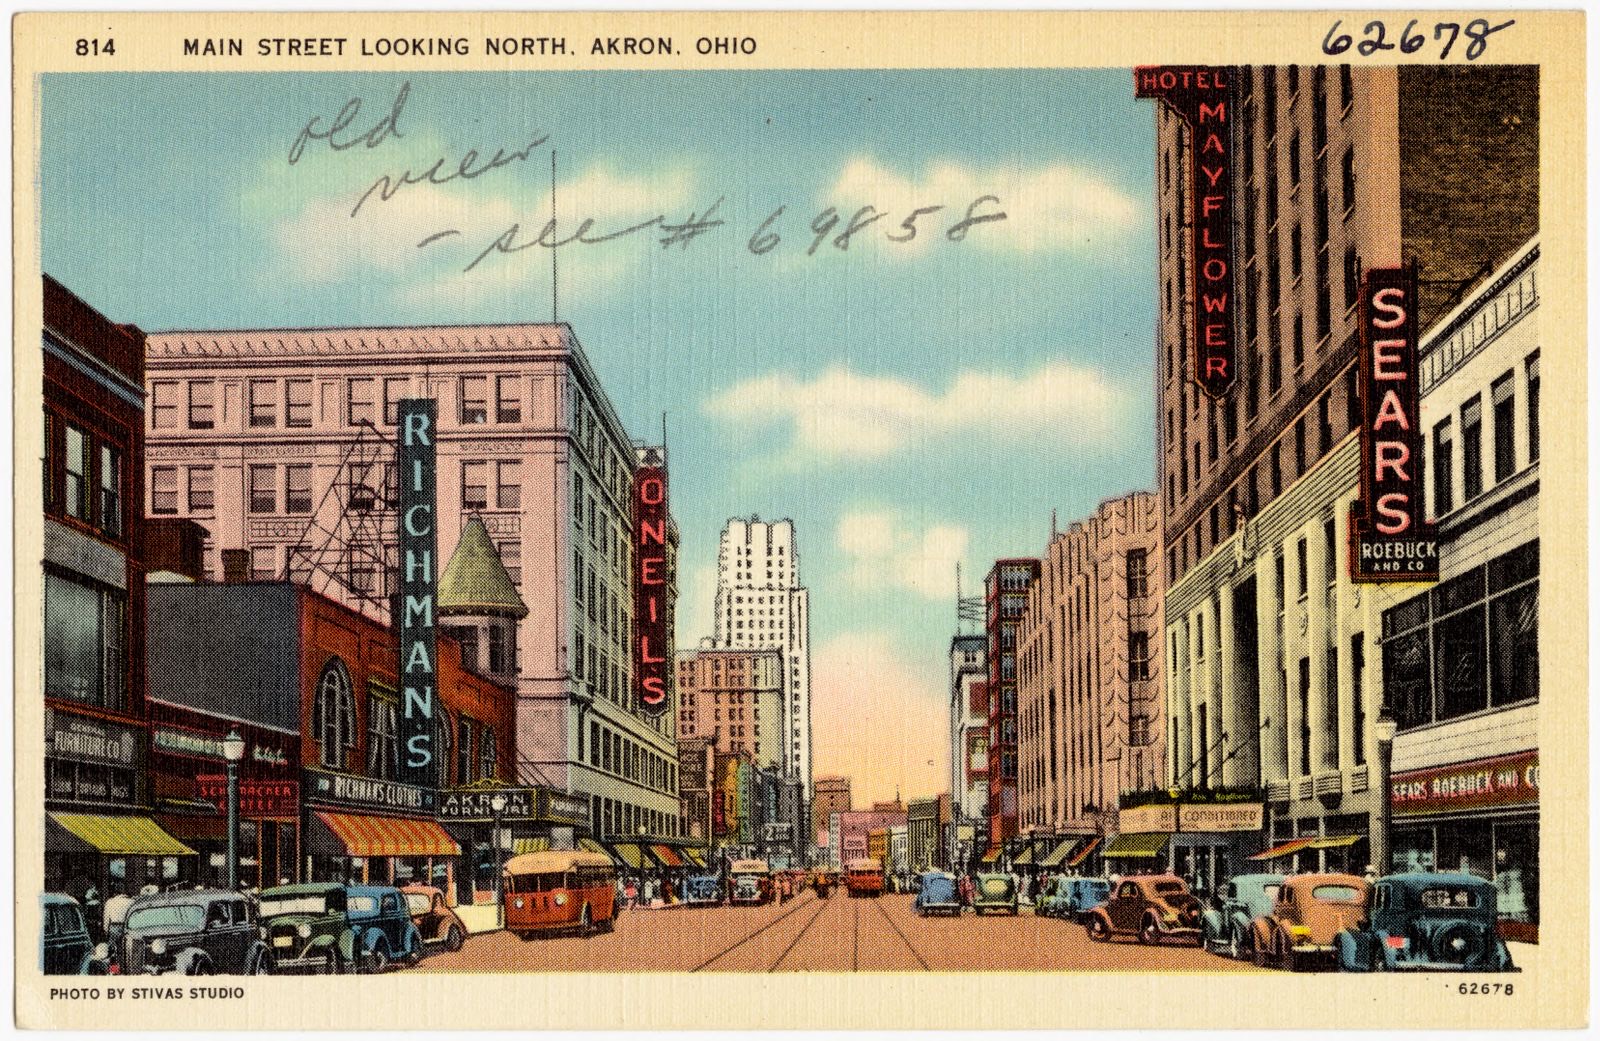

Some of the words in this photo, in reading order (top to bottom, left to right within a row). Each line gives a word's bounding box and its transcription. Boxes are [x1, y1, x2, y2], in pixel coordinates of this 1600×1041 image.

[1322, 18, 1515, 61] 62678
[1142, 71, 1227, 89] HOTEL
[288, 81, 411, 166] old
[464, 214, 664, 272] see
[1199, 102, 1228, 380] MAYFLOWER
[1371, 287, 1411, 535] SEARS
[1361, 541, 1437, 560] ROEBUCK
[1373, 563, 1401, 572] AND
[1407, 562, 1425, 571] CO
[1391, 781, 1428, 802] SEARS
[1433, 769, 1495, 799] ROEBUCK
[1497, 768, 1519, 790] AND
[441, 805, 529, 816] FURNIURE
